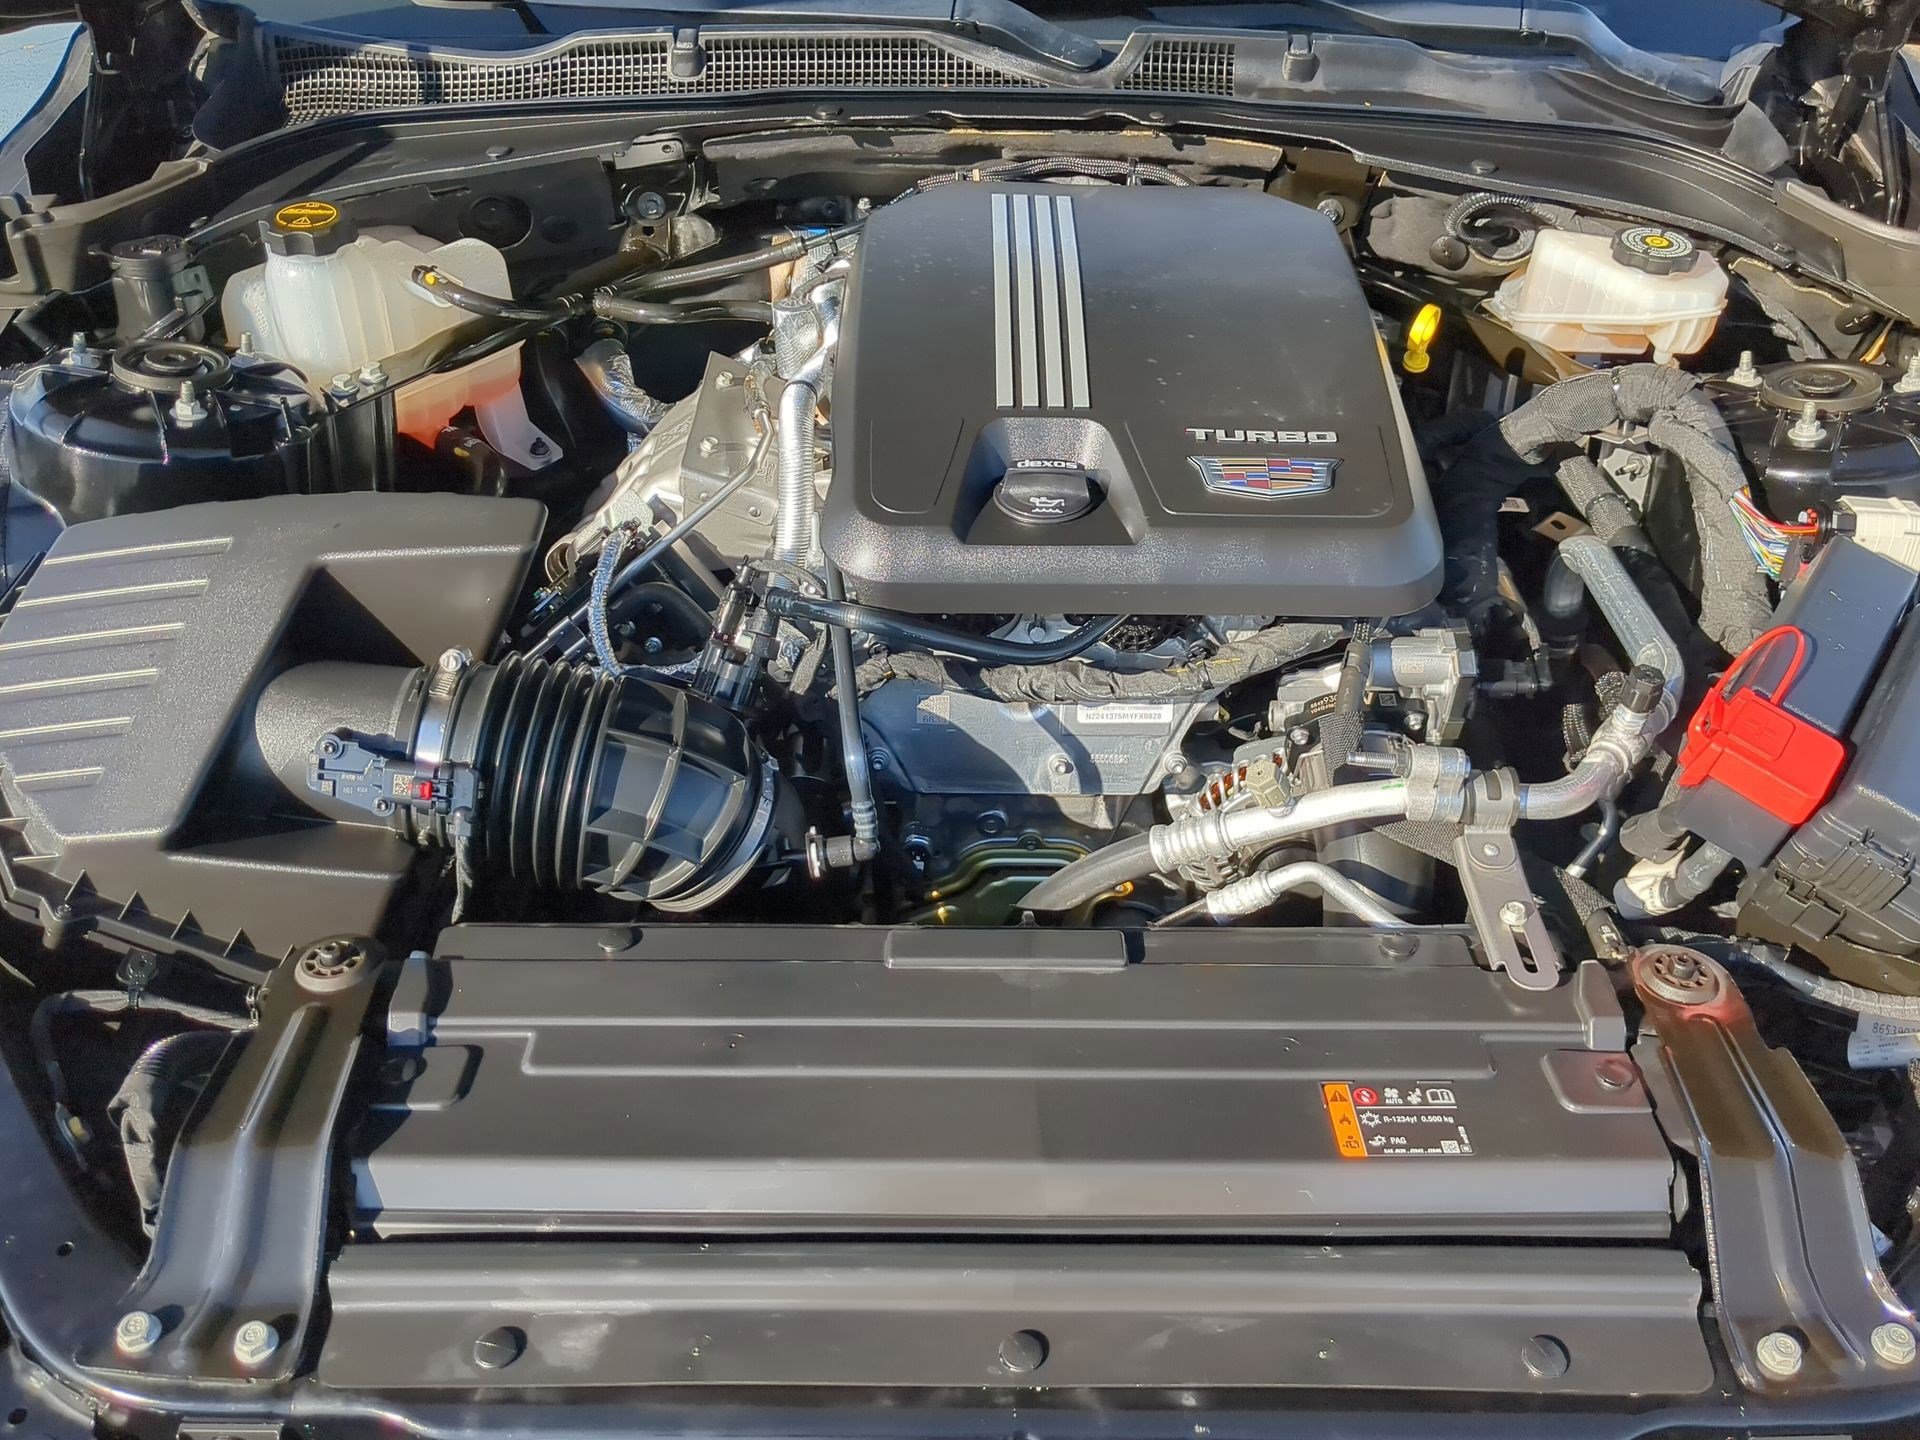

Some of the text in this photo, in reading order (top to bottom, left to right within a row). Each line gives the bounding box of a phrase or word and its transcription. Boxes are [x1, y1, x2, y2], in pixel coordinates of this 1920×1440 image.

[1185, 428, 1338, 444] TURBO
[1016, 459, 1078, 470] dexos
[1420, 1115, 1442, 1123] 0.500
[1443, 1115, 1454, 1124] kg
[1389, 1136, 1407, 1145] PAG
